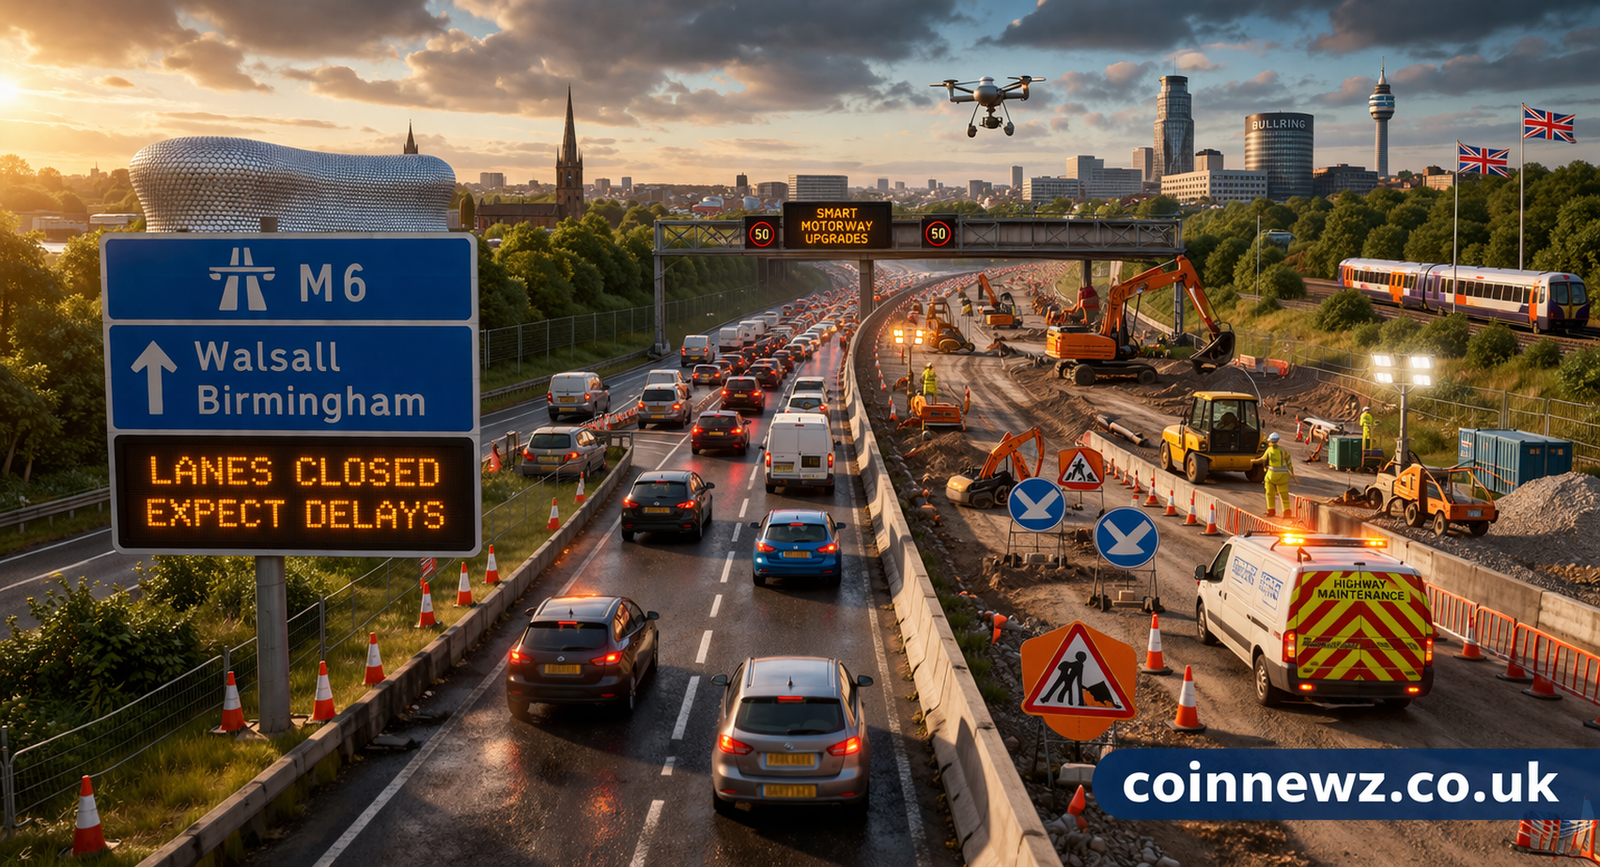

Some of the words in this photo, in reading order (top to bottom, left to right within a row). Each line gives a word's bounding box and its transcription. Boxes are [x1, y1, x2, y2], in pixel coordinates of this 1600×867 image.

[1252, 119, 1306, 130] BULLRING
[816, 207, 858, 219] SMART
[801, 220, 873, 232] MOTORWAY
[755, 228, 769, 240] 50
[805, 233, 869, 244] UPGRADES
[931, 227, 946, 240] 50
[300, 263, 367, 303] M6
[194, 341, 341, 373] Walsall
[198, 385, 426, 424] Birmingham
[150, 456, 273, 486] LANES
[296, 457, 440, 487] CLOSED
[147, 498, 286, 528] EXPECT
[306, 500, 446, 530] DELAYS
[1334, 579, 1387, 589] HIGHWAY
[1317, 589, 1405, 601] MAINTENANCE
